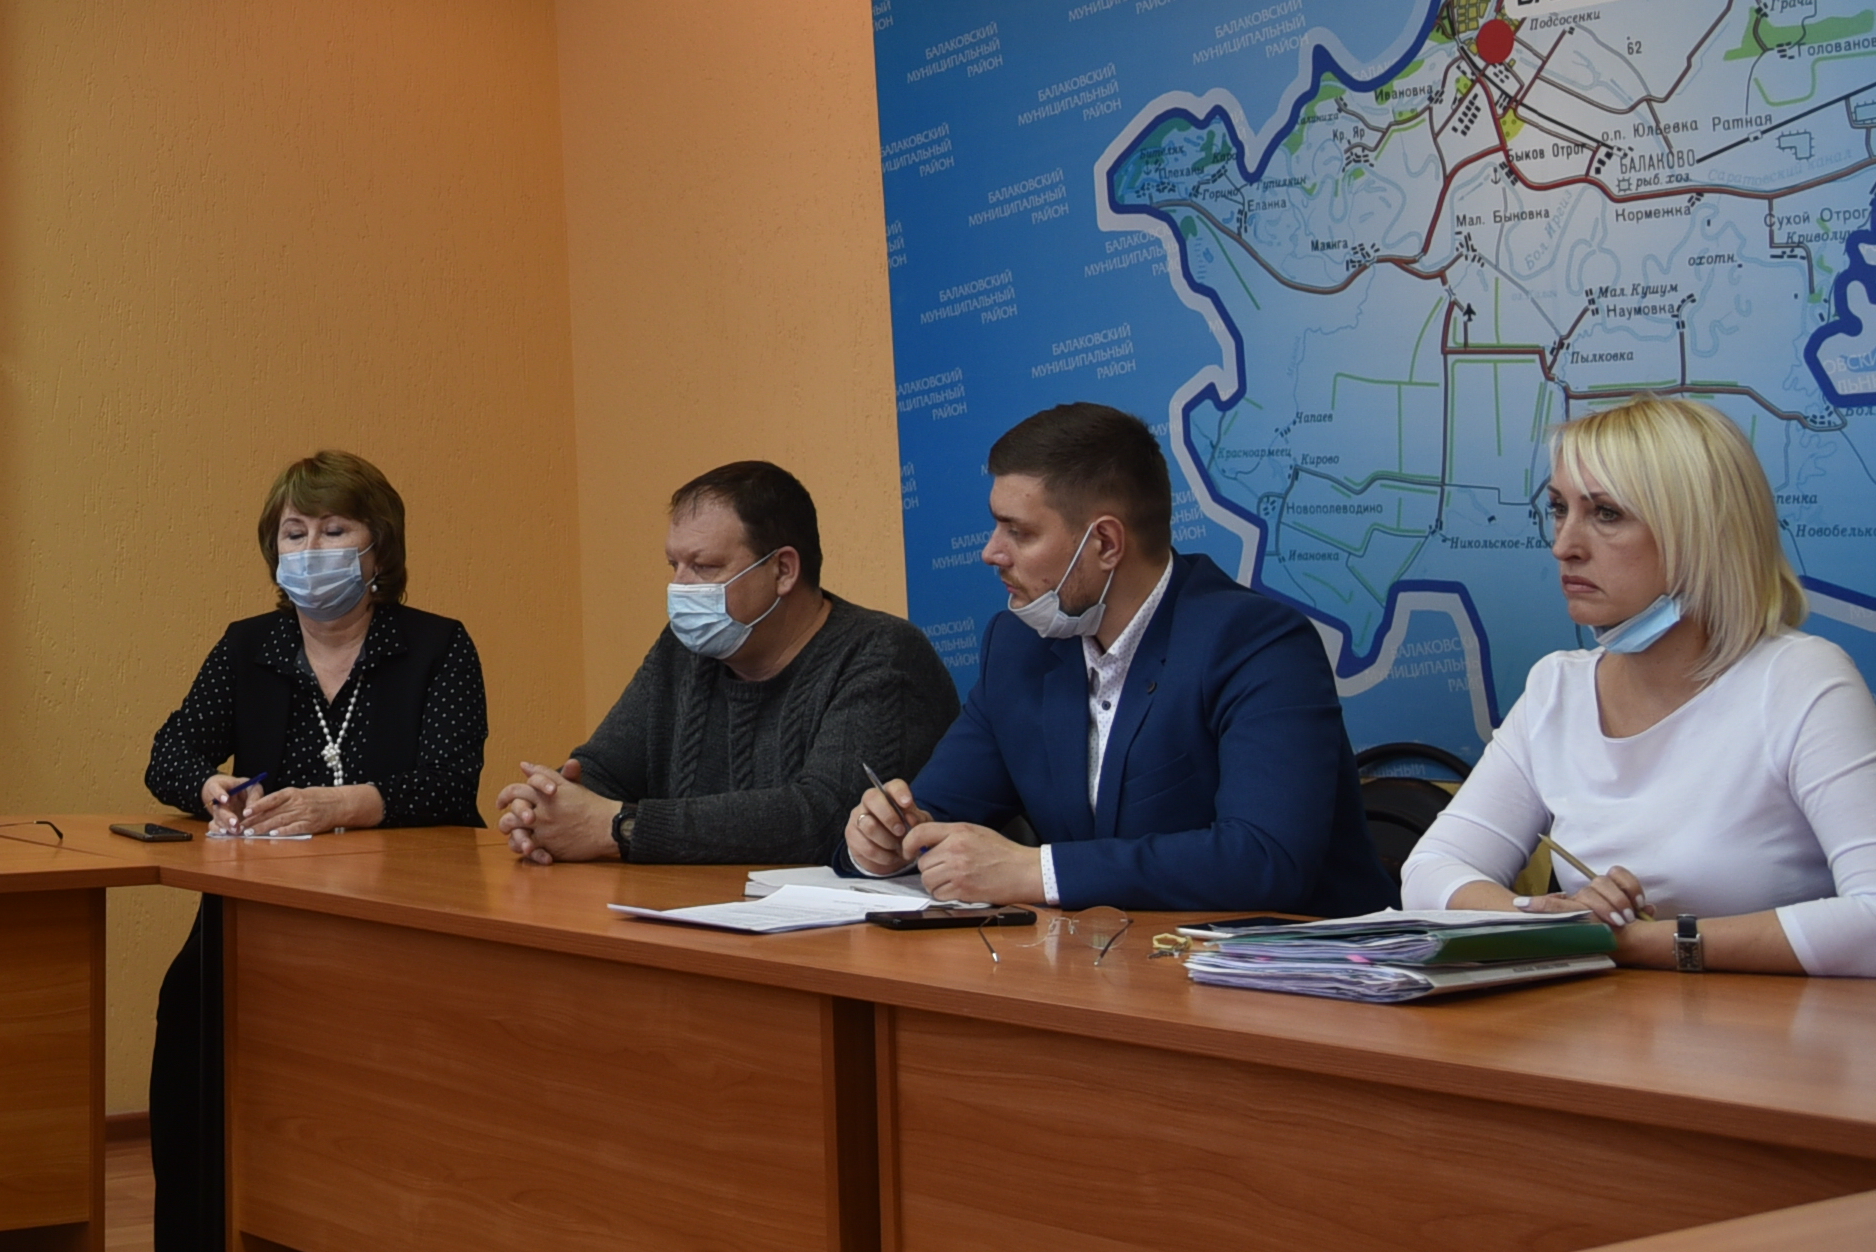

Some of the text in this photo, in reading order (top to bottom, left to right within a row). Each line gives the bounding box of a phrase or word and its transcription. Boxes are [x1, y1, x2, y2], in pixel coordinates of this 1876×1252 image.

[1529, 9, 1601, 31] Подсосенки
[925, 21, 999, 61] БАЛАКОВСКИЙ
[1192, 12, 1306, 65] МУНИЦИПАЛЬНЫЙ
[1265, 32, 1310, 59] РАЙОН
[1627, 41, 1643, 56] 62
[906, 36, 1001, 84] МУНИЦИПАЛЬНЫЙ
[967, 54, 1003, 78] РАЙОН
[1037, 62, 1116, 103] БАЛАКОВСКИЙ
[1374, 84, 1434, 101] Ивановка
[1017, 79, 1119, 127] МУНИЦИПАЛЬНЫЙ
[1082, 97, 1122, 122] РАЙОН
[1352, 126, 1366, 141] Яр
[1632, 119, 1699, 139] Юльевка
[1712, 113, 1773, 133] Ратная
[1508, 142, 1584, 163] Быков Отрог
[1619, 148, 1697, 175] БАЛАКОВО
[918, 155, 955, 178] РАЙОН
[1158, 166, 1204, 180] Плеханы
[988, 167, 1064, 204] БАЛАКОВСКИЙ
[1635, 174, 1664, 191] рыб.
[968, 183, 1067, 227] МУНИЦИПАЛЬНЫЙ
[1031, 202, 1069, 225] РАЙОН
[1247, 198, 1288, 212] Еланка
[1614, 204, 1692, 225] Кормежка
[1455, 206, 1550, 228] Мал. Быковка
[1763, 206, 1869, 231] Сухой Отрог
[1310, 239, 1348, 252] Маянга
[1687, 251, 1738, 267] охотн.
[939, 268, 1013, 303] БАЛАКОВСКИЙ
[1630, 281, 1679, 301] Кушум
[920, 284, 1016, 325] МУНИЦИПАЛЬНЫЙ
[981, 303, 1018, 325] РАЙОН
[1606, 302, 1676, 322] Наумовка
[1052, 322, 1132, 356] БАЛАКОВСКИЙ
[1031, 339, 1134, 379] МУНИЦИПАЛЬНЫЙ
[1570, 350, 1634, 365] Пылковка
[1096, 358, 1137, 380] РАЙОН
[896, 366, 963, 397] АЛАКОВСКИЙ
[931, 401, 968, 421] РАЙОН
[1295, 411, 1334, 424] Чапаев
[1217, 447, 1293, 460] Красноармеец
[1300, 453, 1340, 467] Кирово
[1286, 502, 1384, 516] Новополеводино
[1288, 549, 1340, 562] Ивановка
